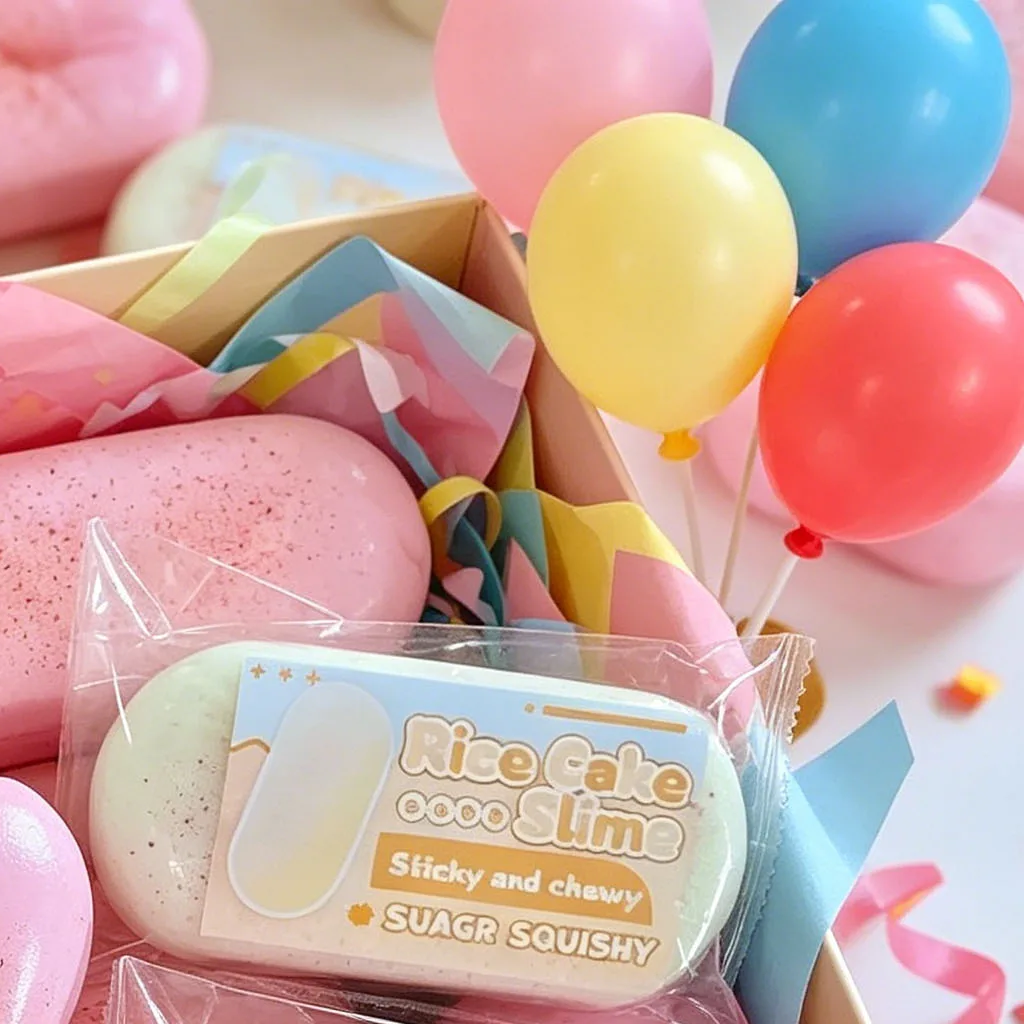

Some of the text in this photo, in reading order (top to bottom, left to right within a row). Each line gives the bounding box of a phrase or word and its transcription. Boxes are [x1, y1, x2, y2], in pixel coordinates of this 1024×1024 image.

[400, 715, 692, 808] Rice Cake
[512, 785, 684, 862] Slime
[389, 851, 643, 913] Sticky and chewy
[381, 902, 660, 967] SUAGR SQUISHY
